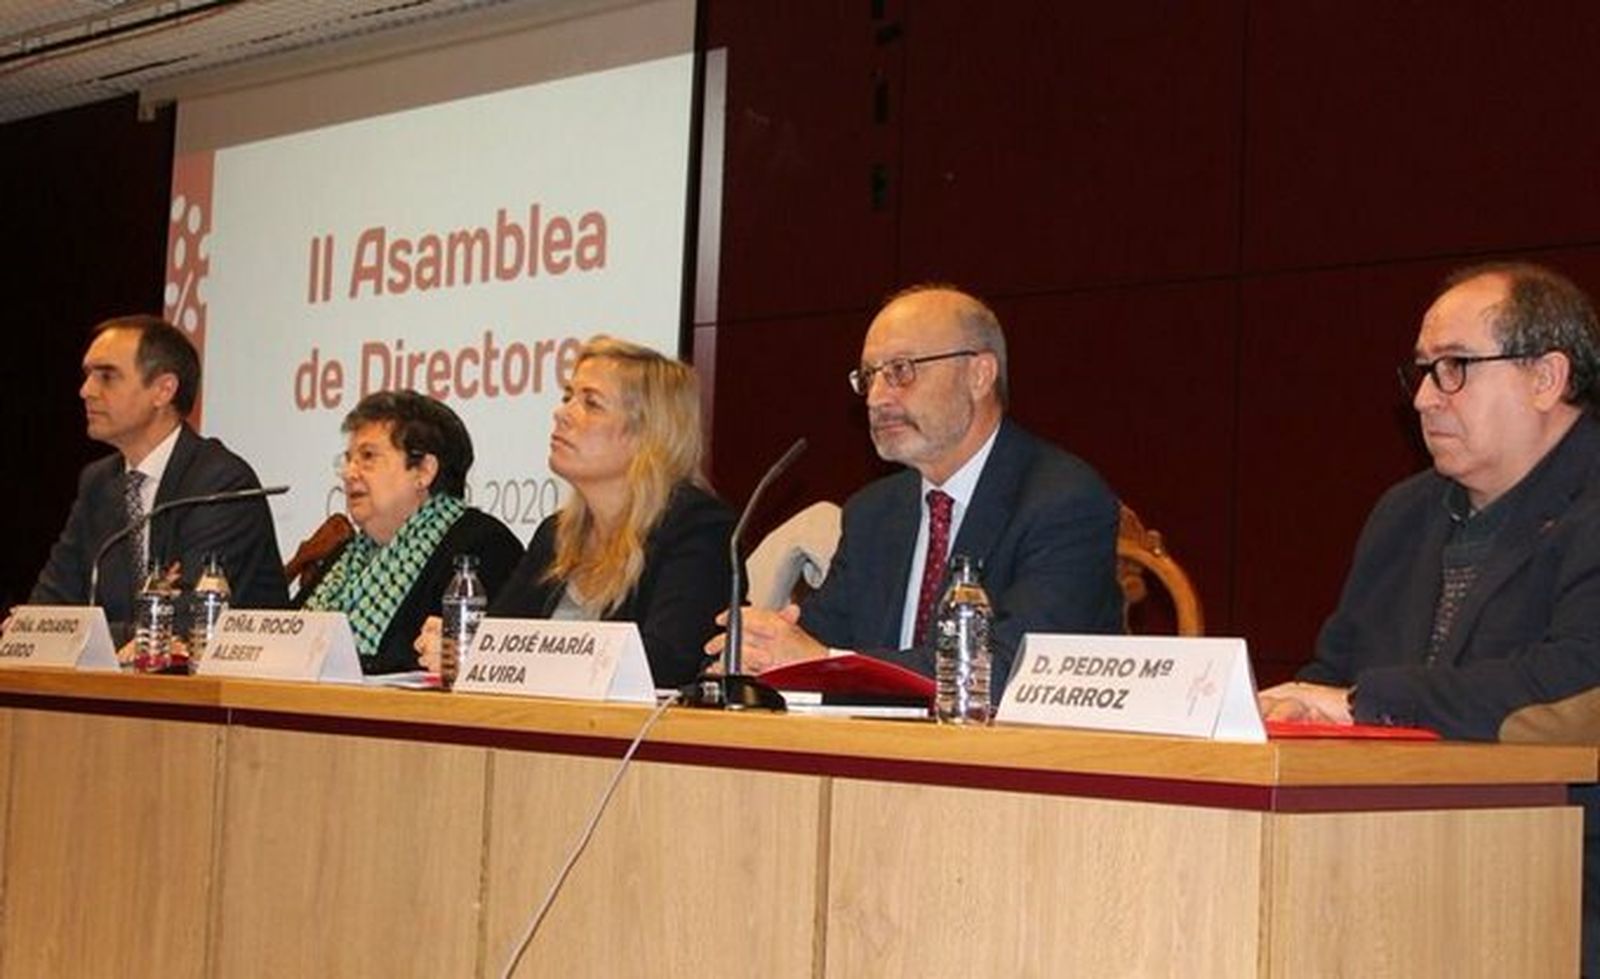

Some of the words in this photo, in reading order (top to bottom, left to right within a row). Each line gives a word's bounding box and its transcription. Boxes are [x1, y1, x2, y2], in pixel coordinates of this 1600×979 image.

[309, 236, 332, 304] II
[350, 206, 607, 298] Asamblea
[294, 349, 344, 411] de
[360, 332, 582, 400] Directore
[486, 479, 559, 524] 2020
[259, 615, 305, 635] ROCÍO
[211, 644, 263, 661] ALBERT
[479, 633, 496, 652] D.
[498, 630, 538, 654] JOSÉ
[539, 632, 596, 656] MARÍA
[466, 664, 526, 685] ALVIRA
[1031, 655, 1052, 675] D.
[1058, 656, 1136, 679] PEDRO
[1014, 683, 1130, 710] USTARROZ
